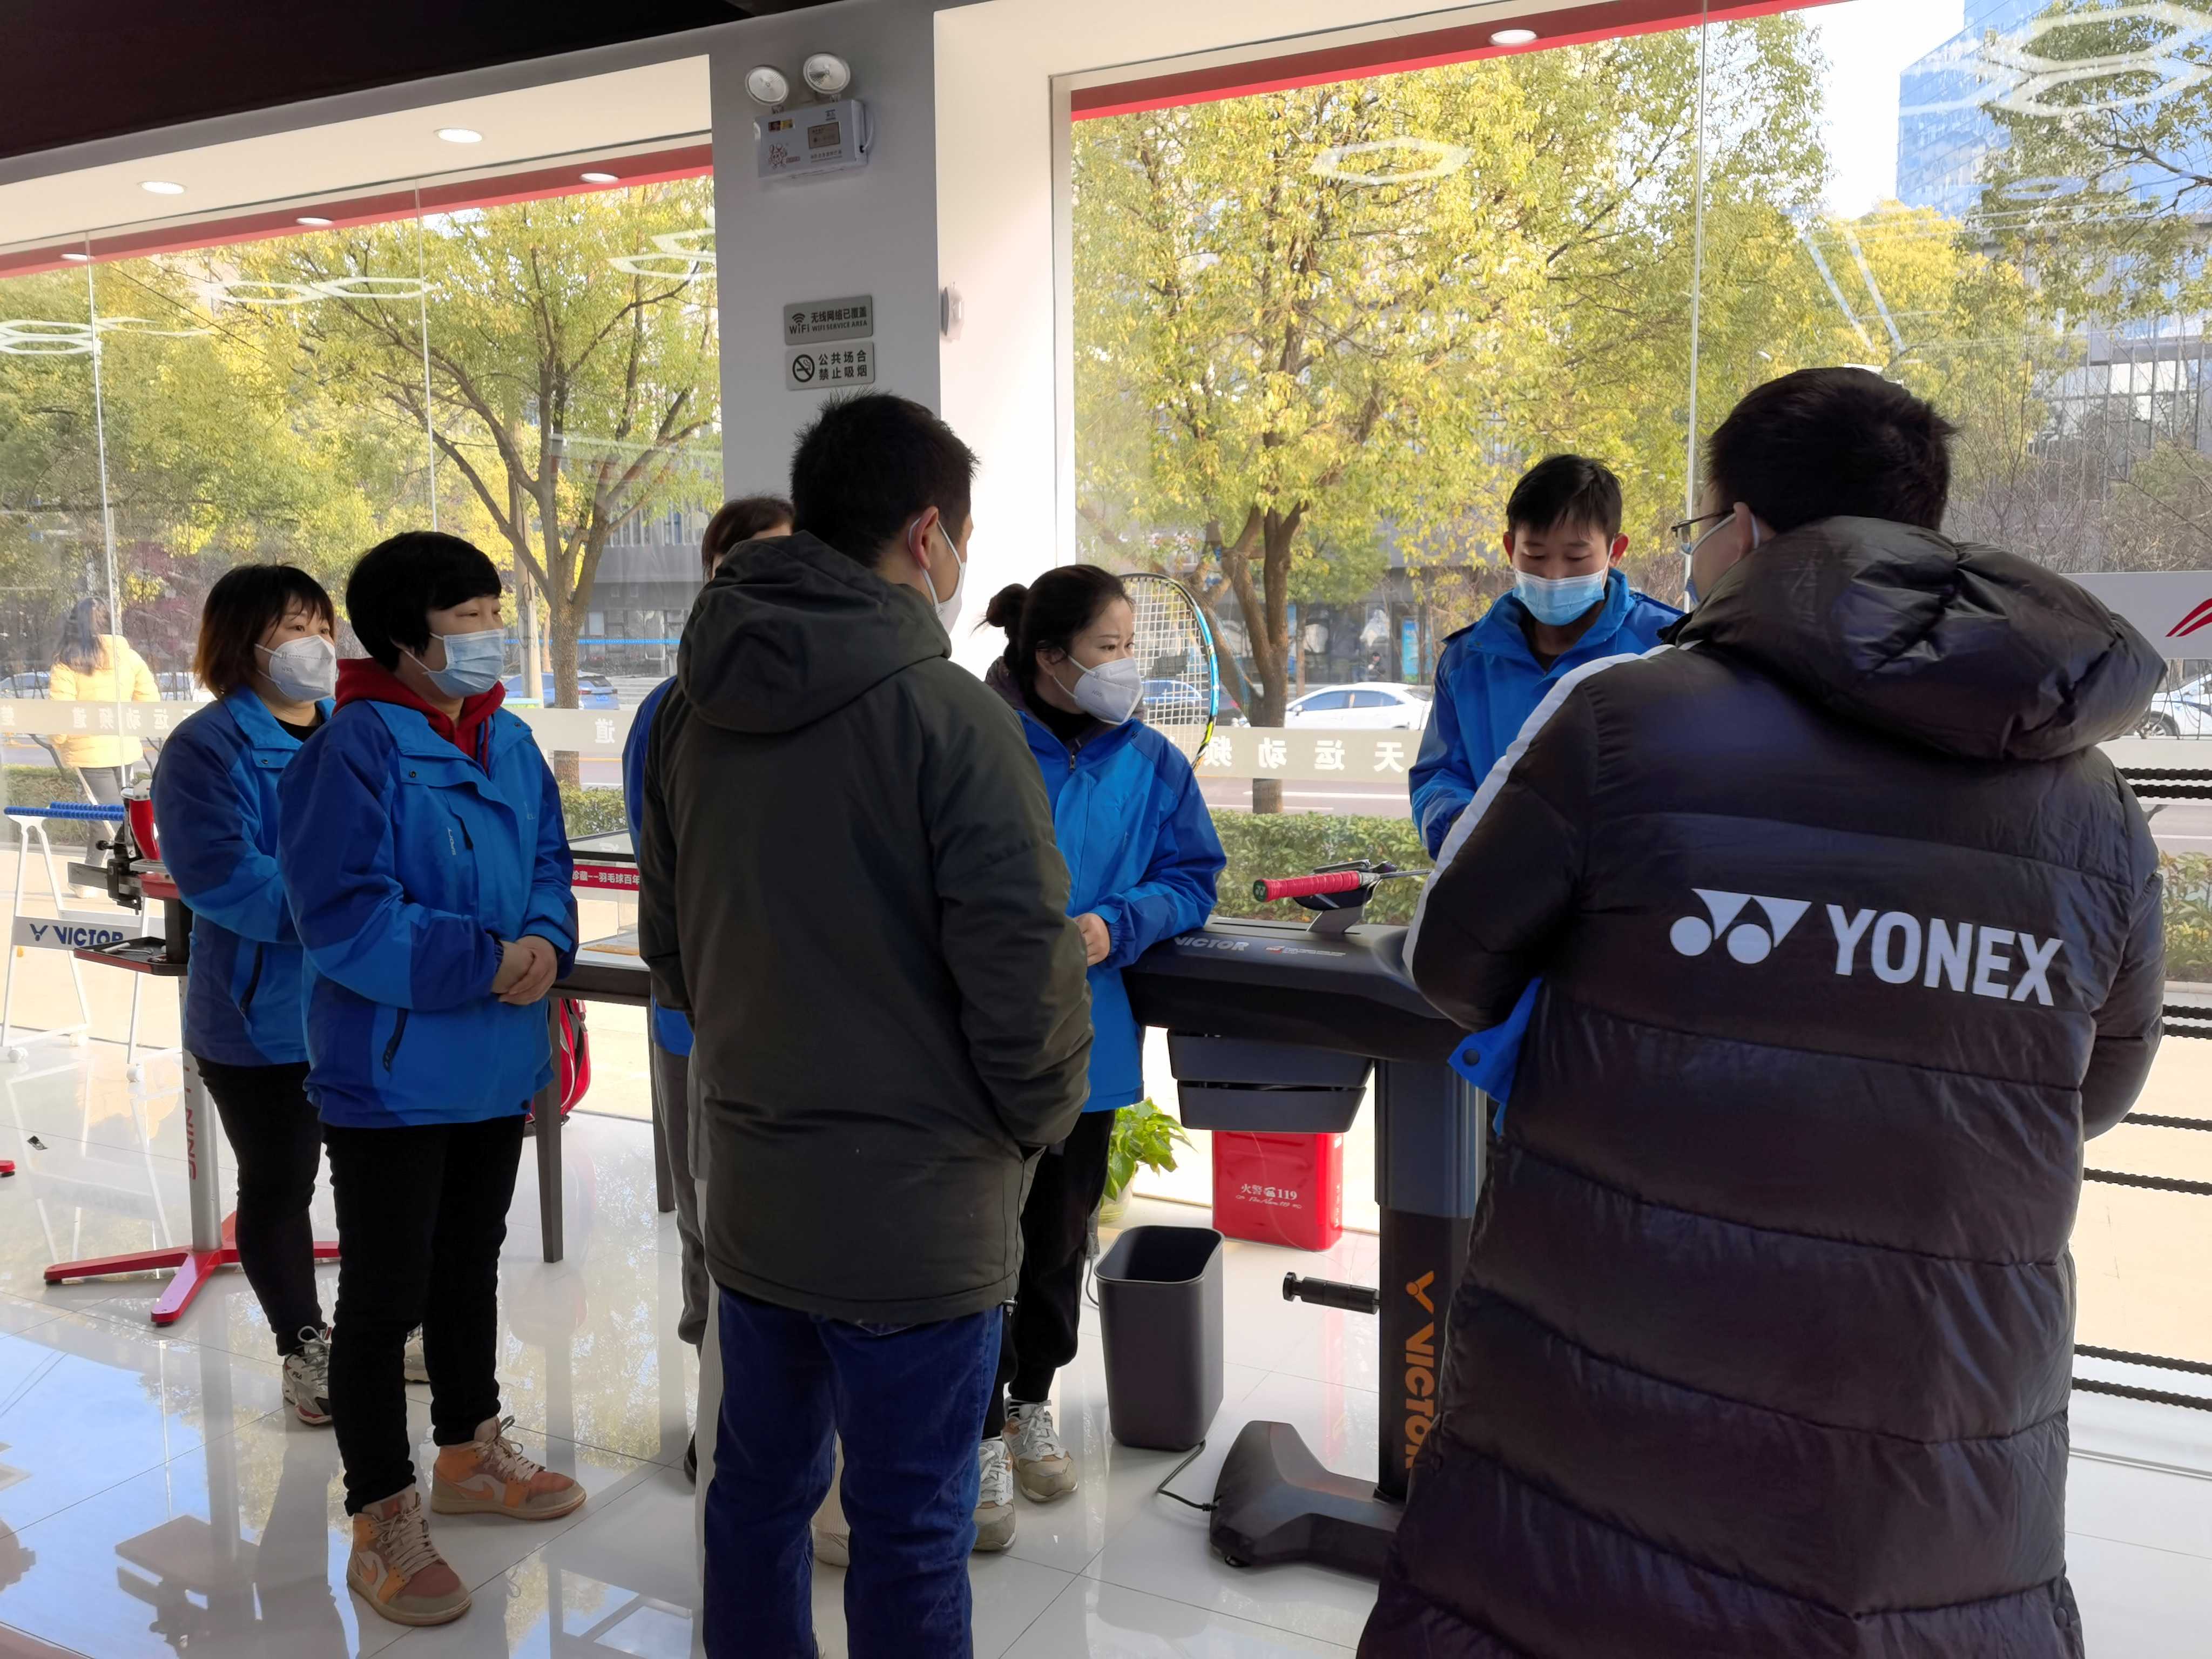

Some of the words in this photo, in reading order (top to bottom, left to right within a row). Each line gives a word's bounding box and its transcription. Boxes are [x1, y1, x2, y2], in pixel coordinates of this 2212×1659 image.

[811, 306, 867, 323] 无线网络已覆盖
[789, 323, 810, 334] WiFi
[812, 324, 826, 332] WIFI
[827, 322, 850, 331] SERVICE
[819, 350, 867, 366] 公共场合
[819, 365, 867, 380] 禁止吸烟
[1174, 937, 1249, 951] VICTOR
[1826, 904, 2063, 1006] YONEX
[1278, 1189, 1298, 1201] 119
